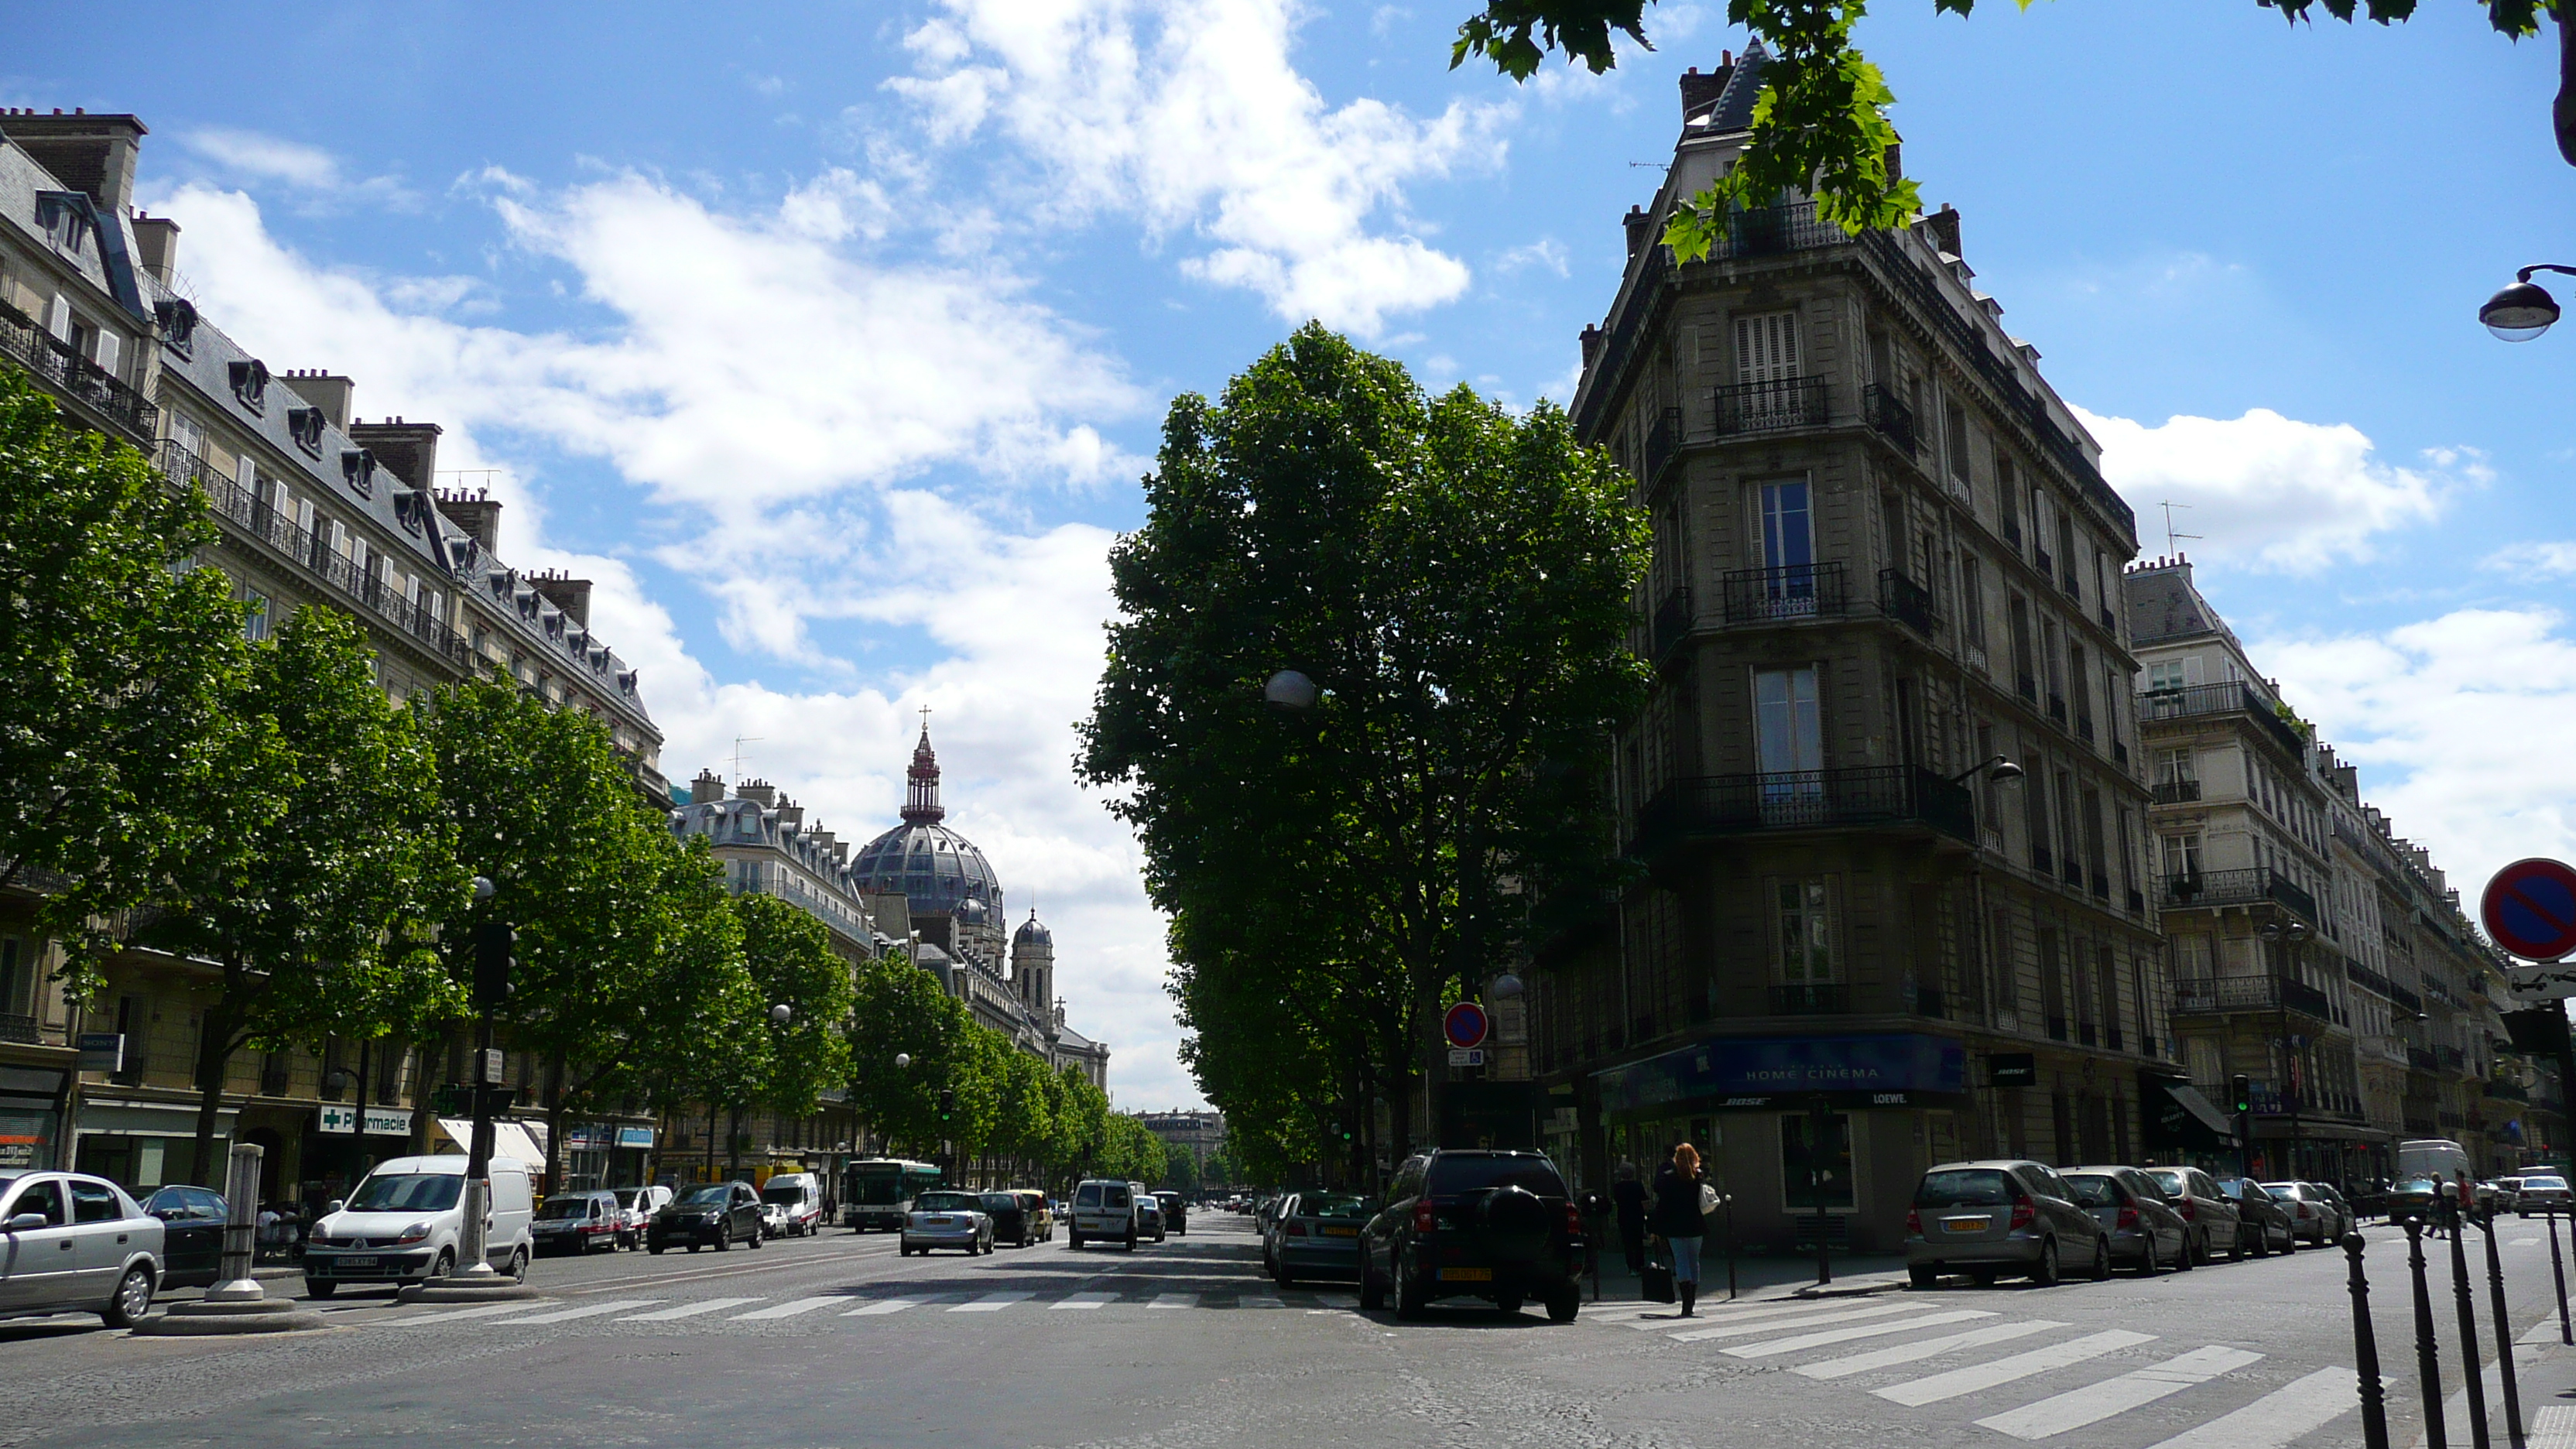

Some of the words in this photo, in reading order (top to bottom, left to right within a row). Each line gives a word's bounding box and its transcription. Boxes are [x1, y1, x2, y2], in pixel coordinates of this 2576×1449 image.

[1746, 1070, 1797, 1081] HOME
[1807, 1068, 1879, 1080] CINEMA
[1718, 1097, 1772, 1107] BOSE
